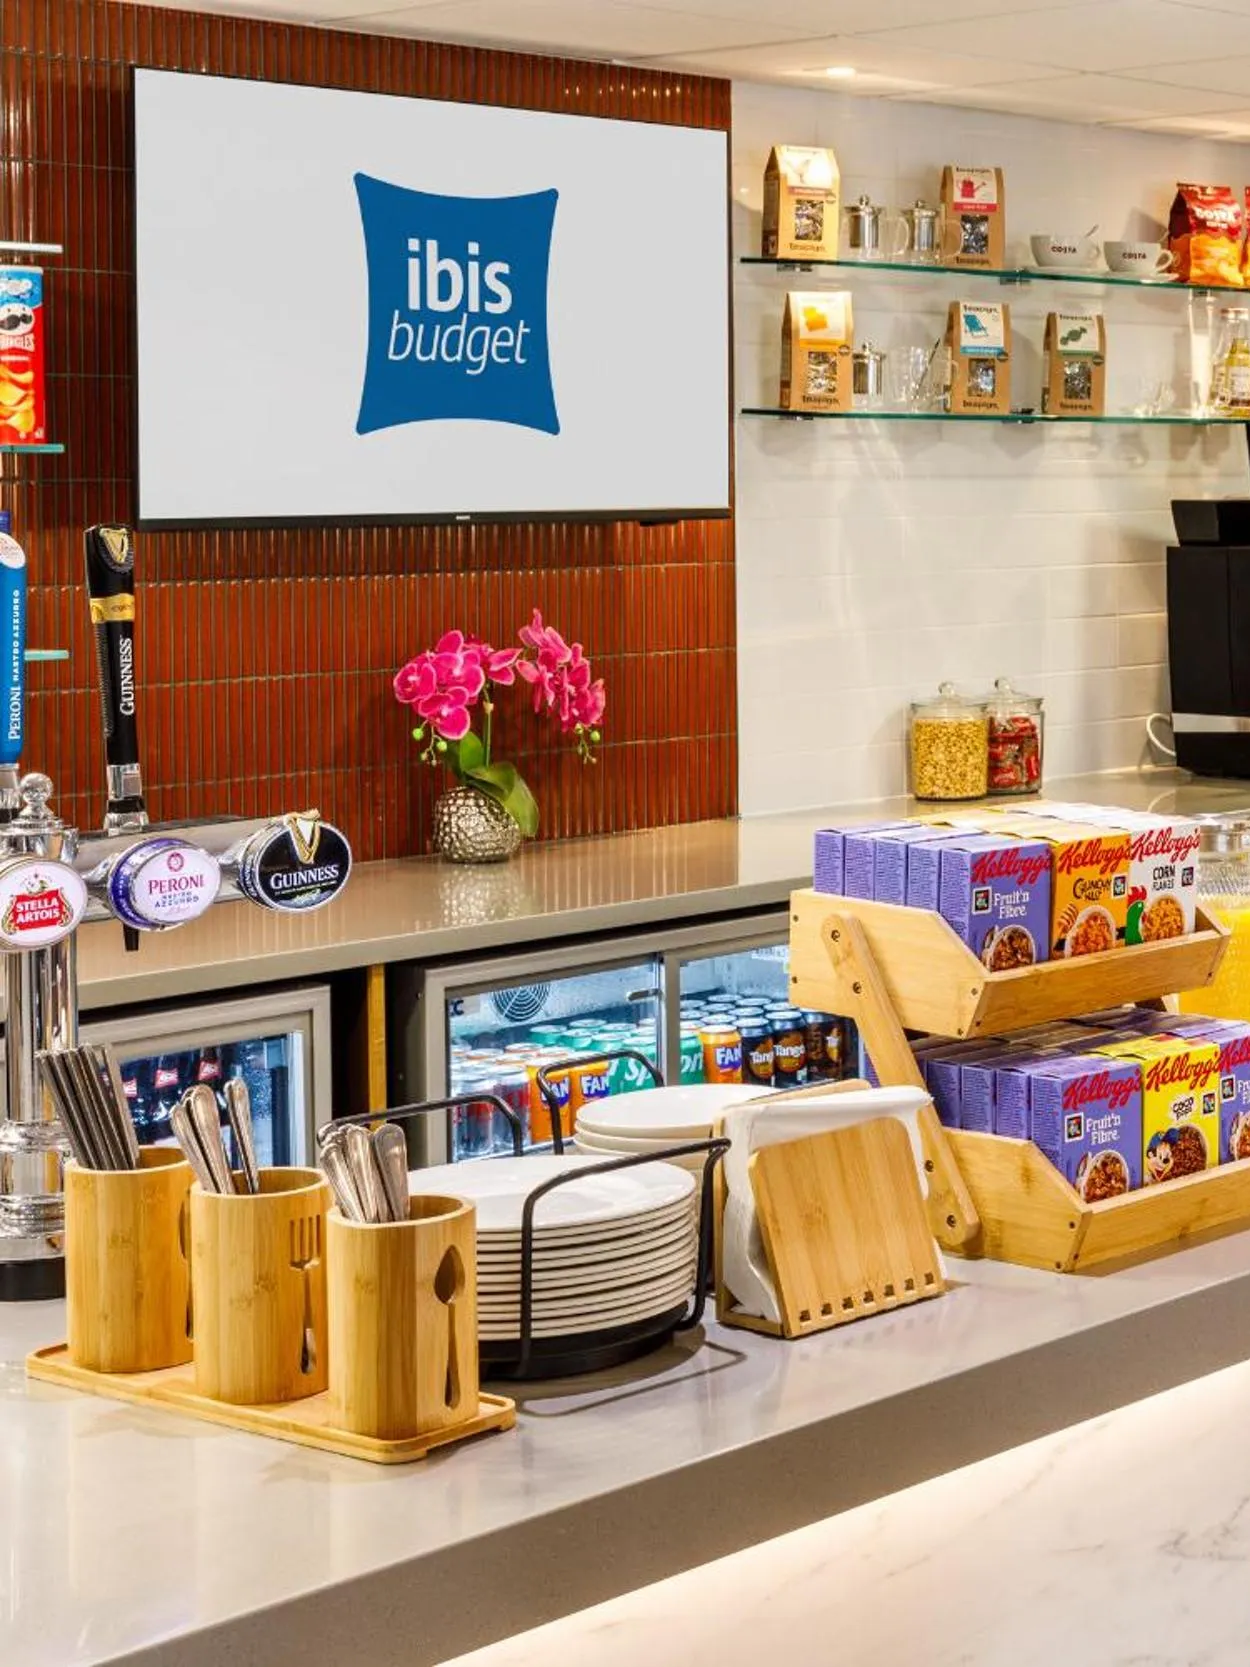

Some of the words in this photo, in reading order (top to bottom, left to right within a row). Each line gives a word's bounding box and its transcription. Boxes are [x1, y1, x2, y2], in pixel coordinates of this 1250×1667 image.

[407, 238, 513, 314] ibis
[388, 309, 531, 375] budget
[119, 637, 135, 716] GUINNESS
[8, 685, 21, 740] PERONI
[1130, 827, 1200, 863] Kellogg's
[270, 863, 339, 890] GUINNESS
[1152, 865, 1176, 881] CORN
[148, 874, 205, 896] PERONI
[16, 896, 59, 912] STELLA
[999, 904, 1028, 920] Fibre
[16, 908, 61, 924] ARTOIS
[717, 1044, 742, 1065] FAN
[1172, 1096, 1194, 1113] COCO
[1091, 1129, 1120, 1146] Fibre
